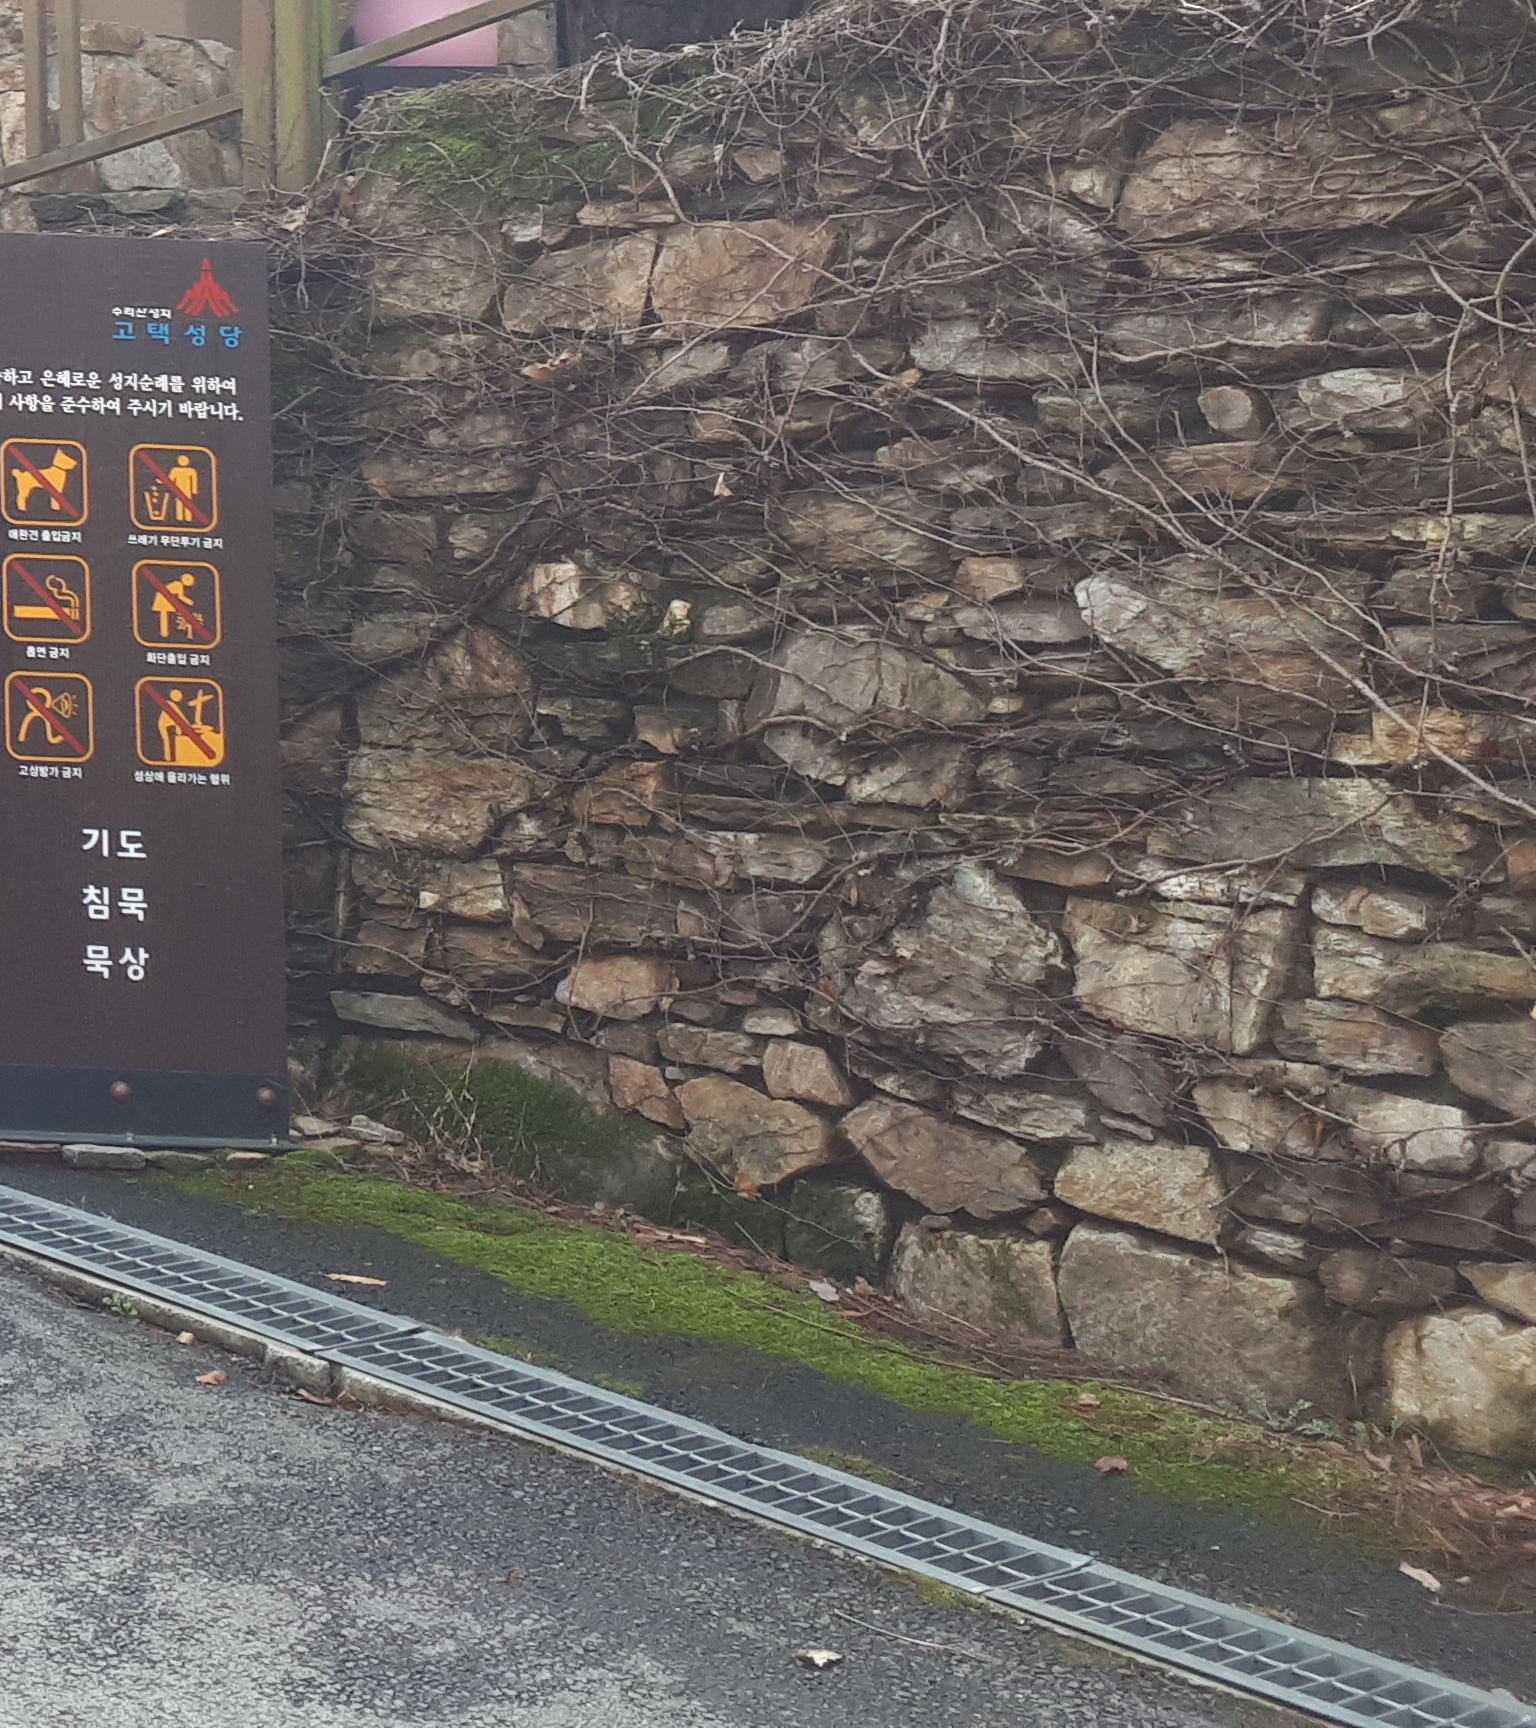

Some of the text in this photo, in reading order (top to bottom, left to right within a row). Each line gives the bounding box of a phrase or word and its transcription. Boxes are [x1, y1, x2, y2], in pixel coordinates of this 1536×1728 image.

[112, 307, 171, 318] 수리산성지
[40, 370, 102, 389] 은혜로운
[109, 372, 185, 392] 성지순례를
[191, 376, 236, 395] 위하여
[9, 393, 55, 412] 사항을
[60, 396, 120, 415] 준수하여
[127, 399, 172, 417] 주시기
[179, 401, 243, 420] 바랍니다.
[41, 529, 82, 543] 출입금지
[127, 534, 223, 549] 쓰레기 무단투기 금지
[48, 646, 69, 659] 금지
[189, 653, 210, 666] 금지
[18, 765, 83, 779] 고성방가 금지
[82, 829, 147, 857] 기도
[83, 885, 147, 921] 침묵
[83, 945, 149, 980] 묵상
